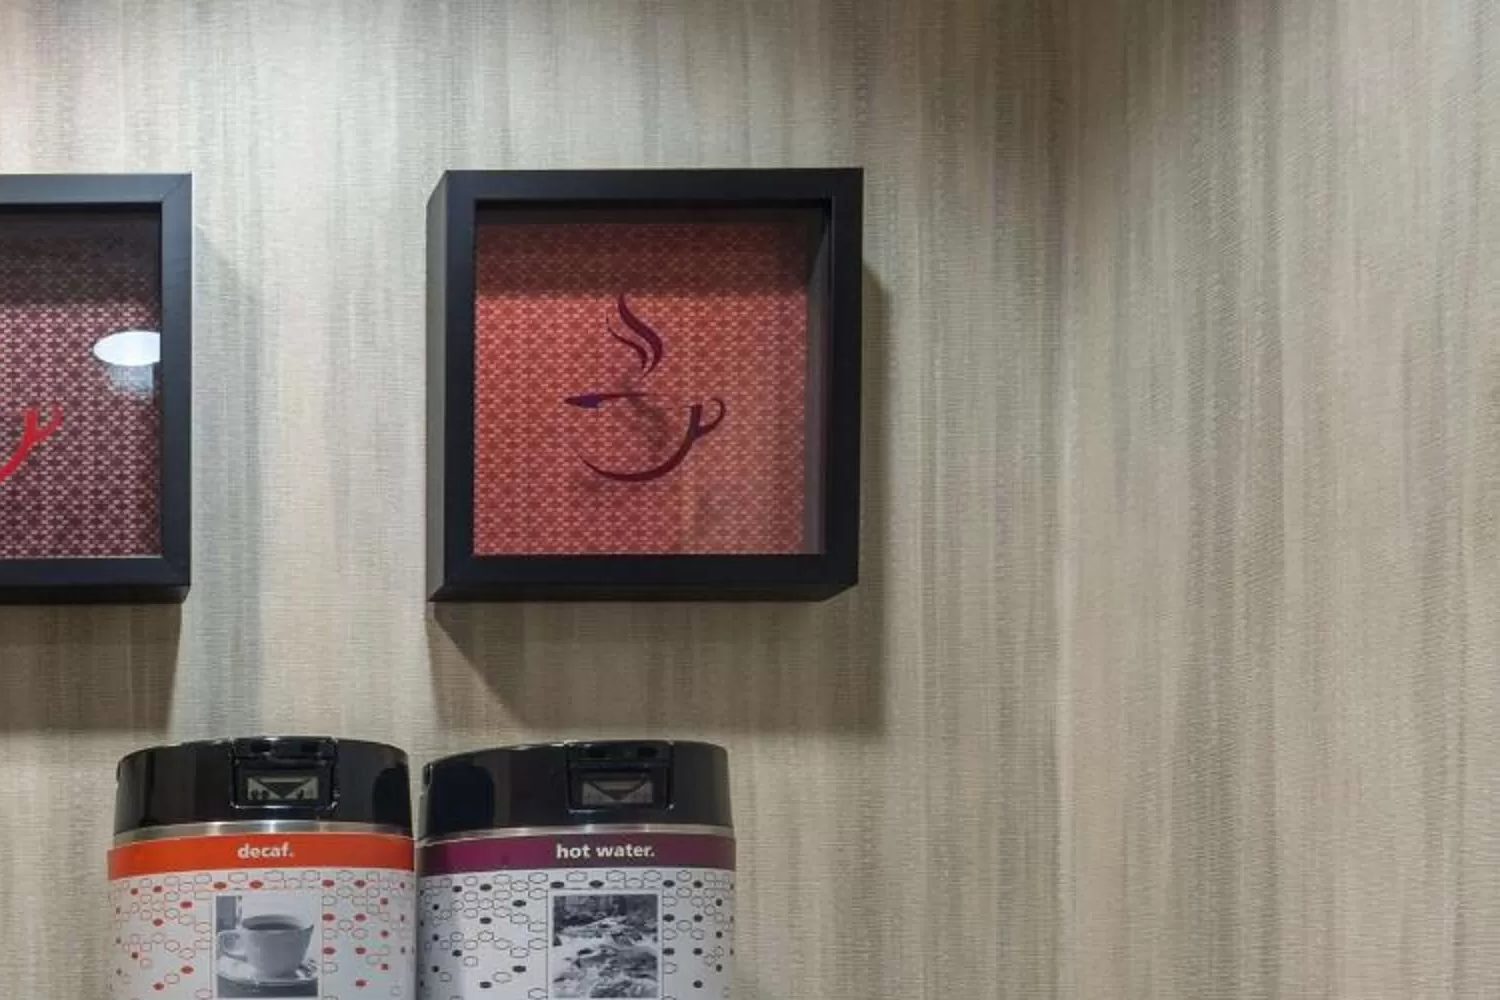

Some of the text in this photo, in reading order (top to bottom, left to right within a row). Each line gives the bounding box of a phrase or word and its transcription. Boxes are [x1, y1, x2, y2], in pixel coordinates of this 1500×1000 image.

[237, 842, 295, 859] decaf.
[556, 843, 656, 859] hot water.
